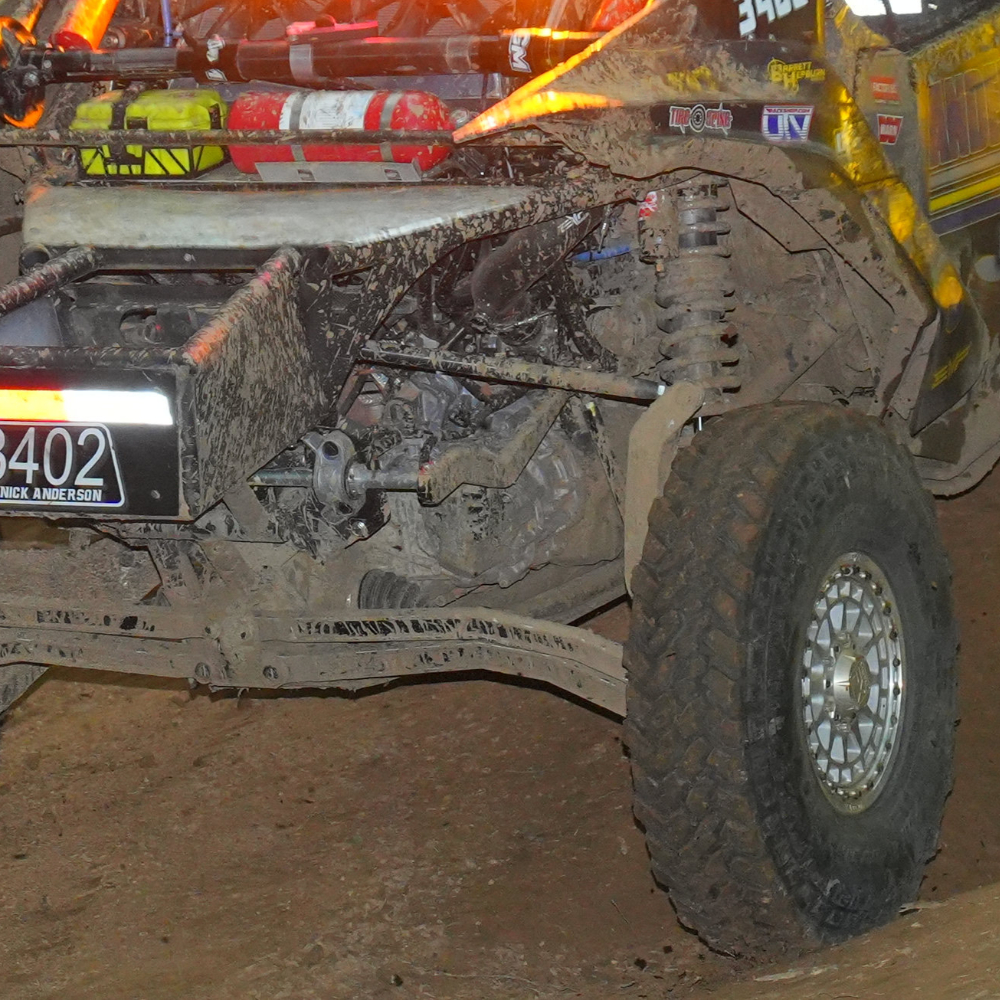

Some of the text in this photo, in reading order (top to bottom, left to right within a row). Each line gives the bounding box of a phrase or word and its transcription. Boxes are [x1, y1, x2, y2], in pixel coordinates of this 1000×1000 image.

[763, 114, 809, 141] UTV
[0, 427, 106, 486] 402
[0, 486, 102, 502] NICK ANDERSON
